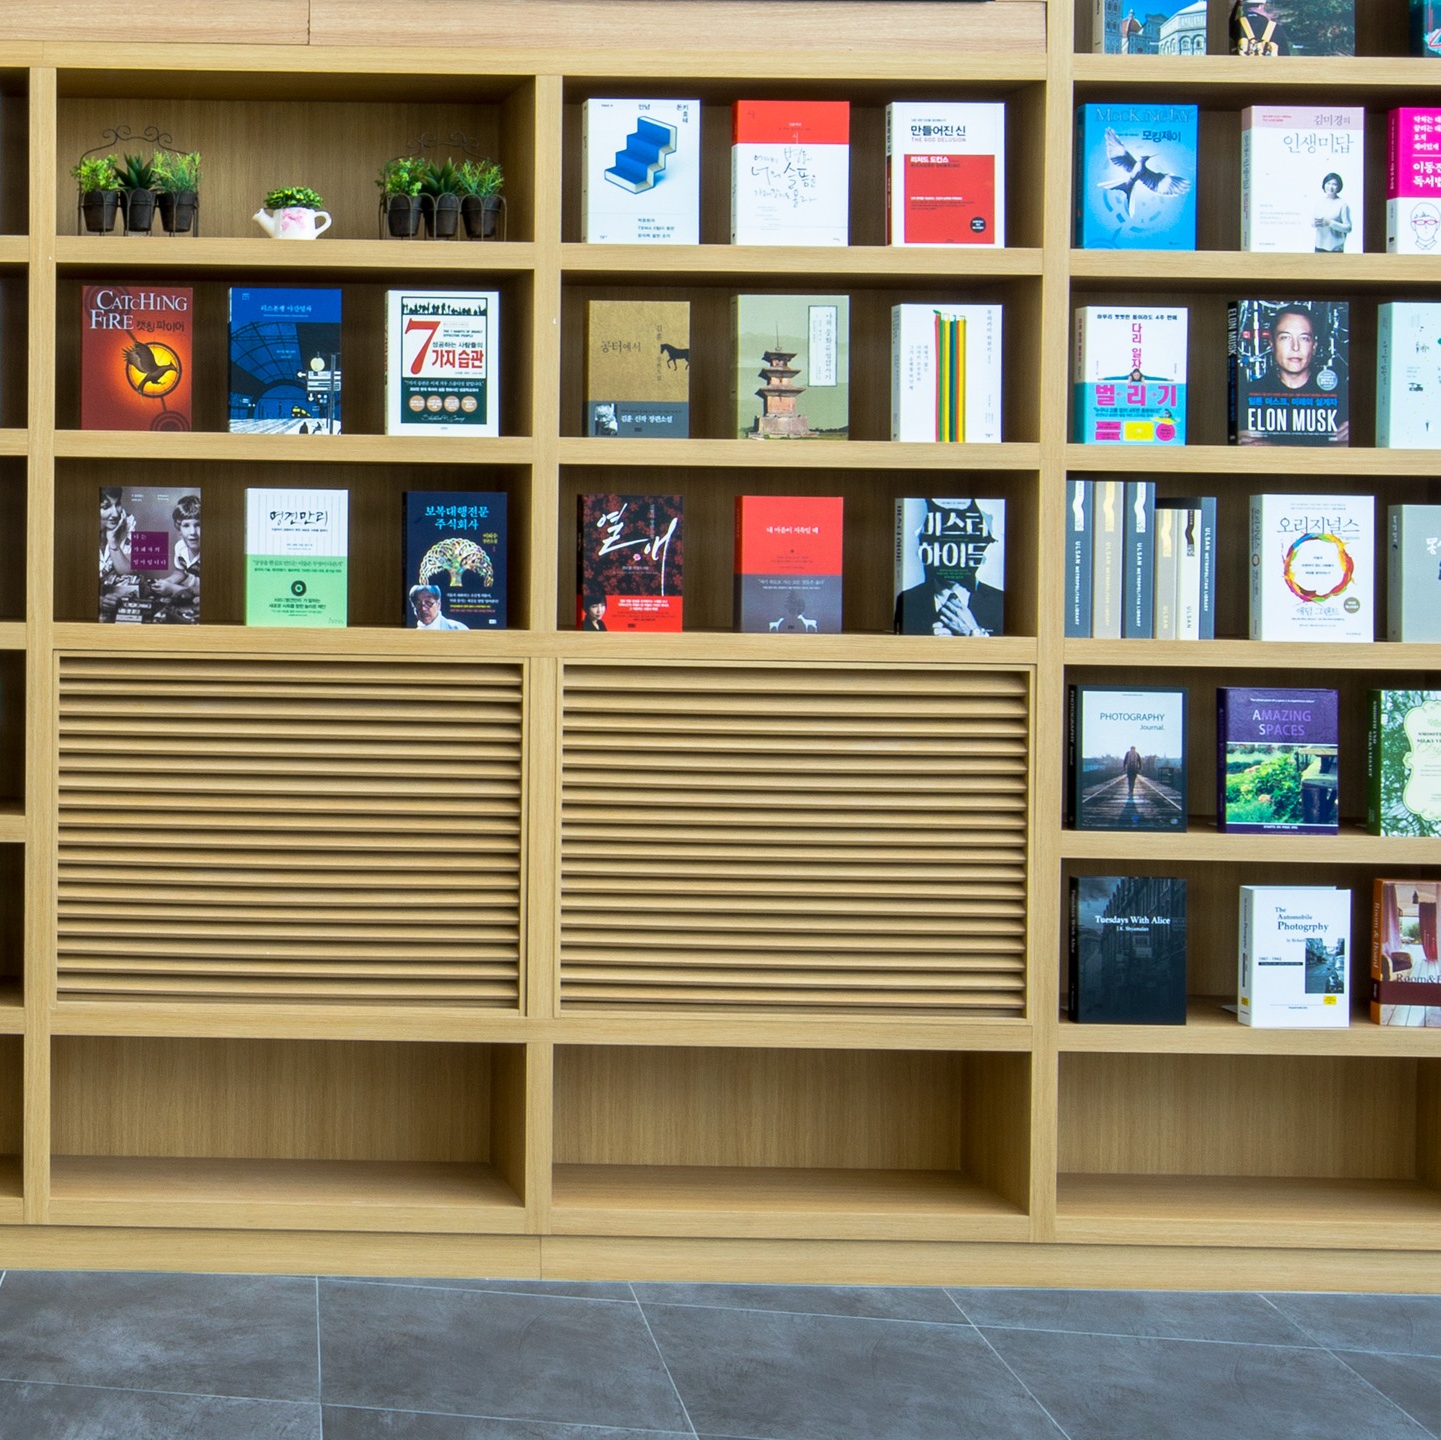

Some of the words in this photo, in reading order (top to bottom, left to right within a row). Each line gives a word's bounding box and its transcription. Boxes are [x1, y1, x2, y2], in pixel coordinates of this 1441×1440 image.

[911, 126, 952, 137] 만들어진
[955, 126, 966, 137] 신
[1142, 130, 1181, 142] 모킹제이
[1283, 135, 1354, 154] 인생미답
[96, 291, 188, 311] CATCHING
[89, 311, 133, 331] FIRE
[405, 320, 442, 375] 7
[432, 350, 456, 368] 가지
[458, 349, 483, 369] 습관
[425, 505, 489, 518] 보복대행전문
[435, 518, 479, 531] 주식회사
[1276, 516, 1360, 534] 오리지널스
[1100, 713, 1165, 722] PHOTOGRAPHY
[1253, 709, 1311, 722] AMAZING
[1259, 723, 1305, 736] SPACES
[1095, 916, 1128, 925] Tuesdays
[1131, 916, 1148, 924] With
[1151, 916, 1170, 925] Alice
[1278, 921, 1328, 932] Photogrphy
